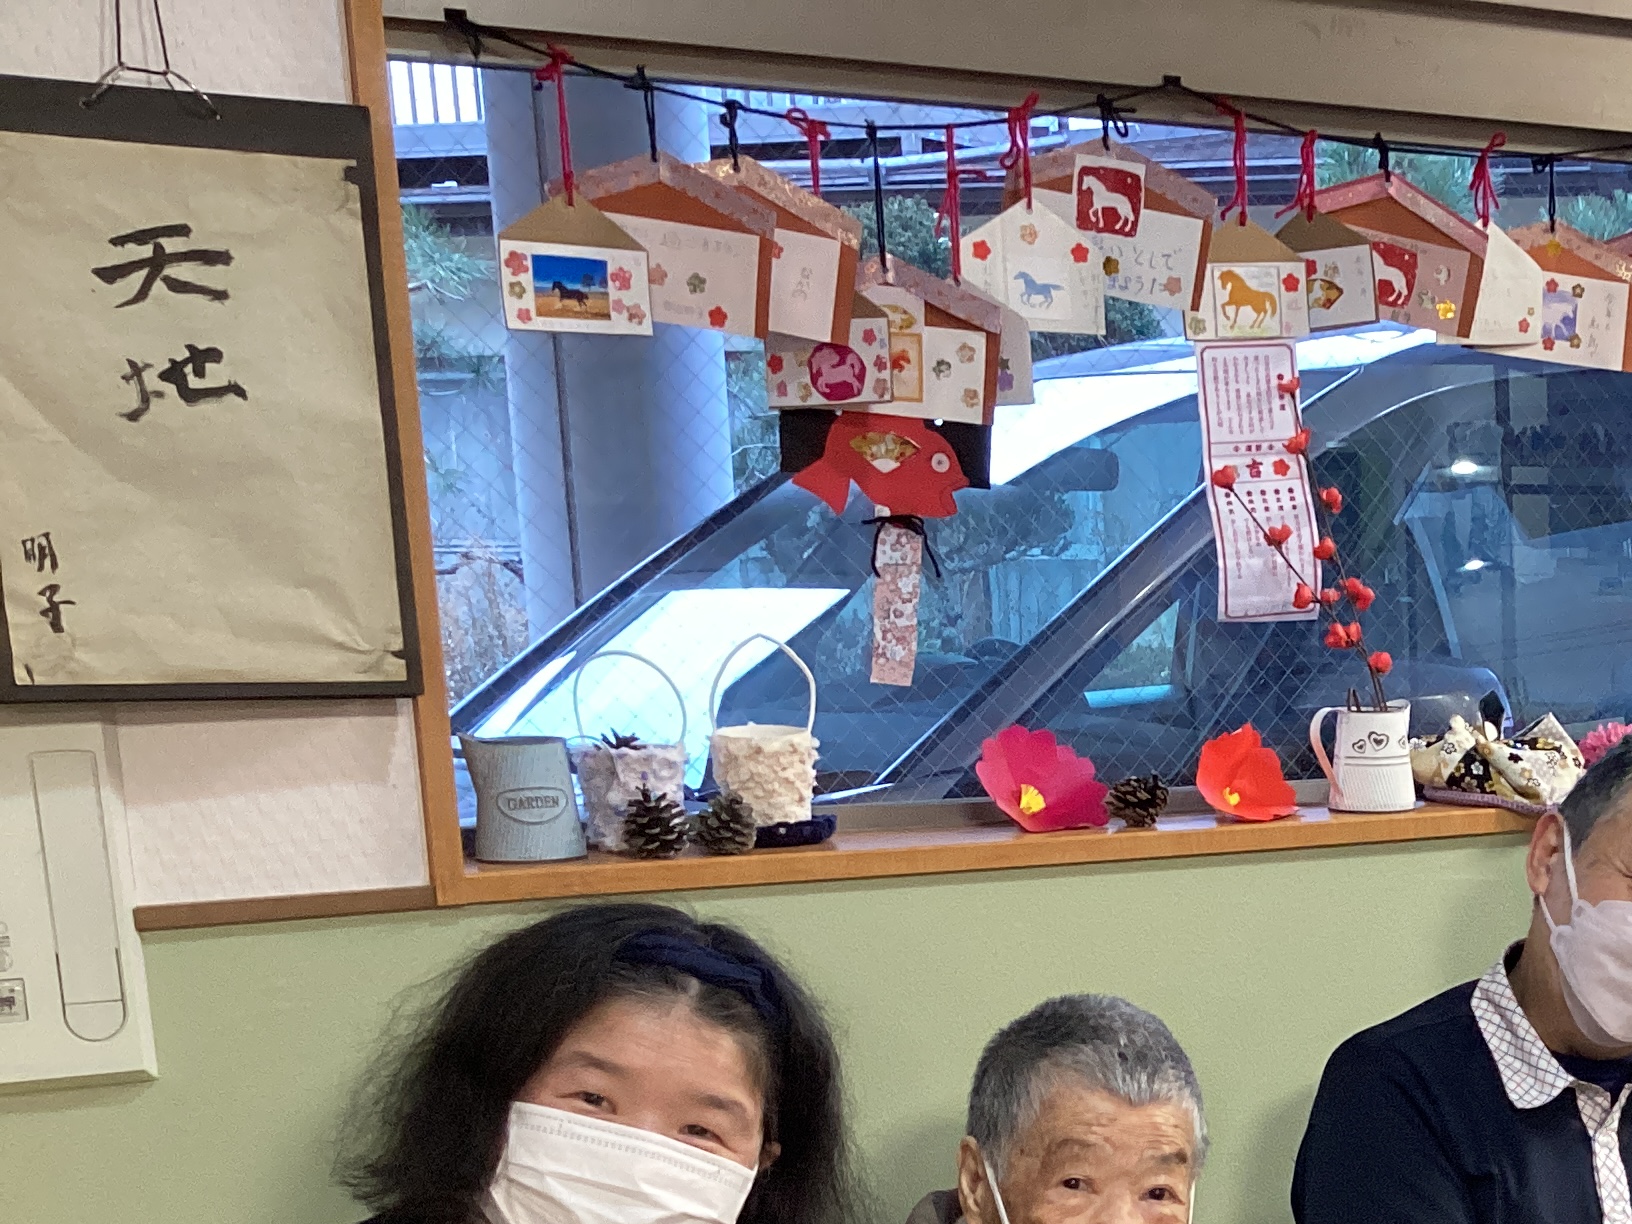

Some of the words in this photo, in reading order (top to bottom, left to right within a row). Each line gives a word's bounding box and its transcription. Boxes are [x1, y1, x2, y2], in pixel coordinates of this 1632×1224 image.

[92, 222, 249, 423] 天地
[1245, 457, 1264, 479] 吉
[22, 532, 76, 634] 明子
[506, 794, 560, 812] GARDEN
